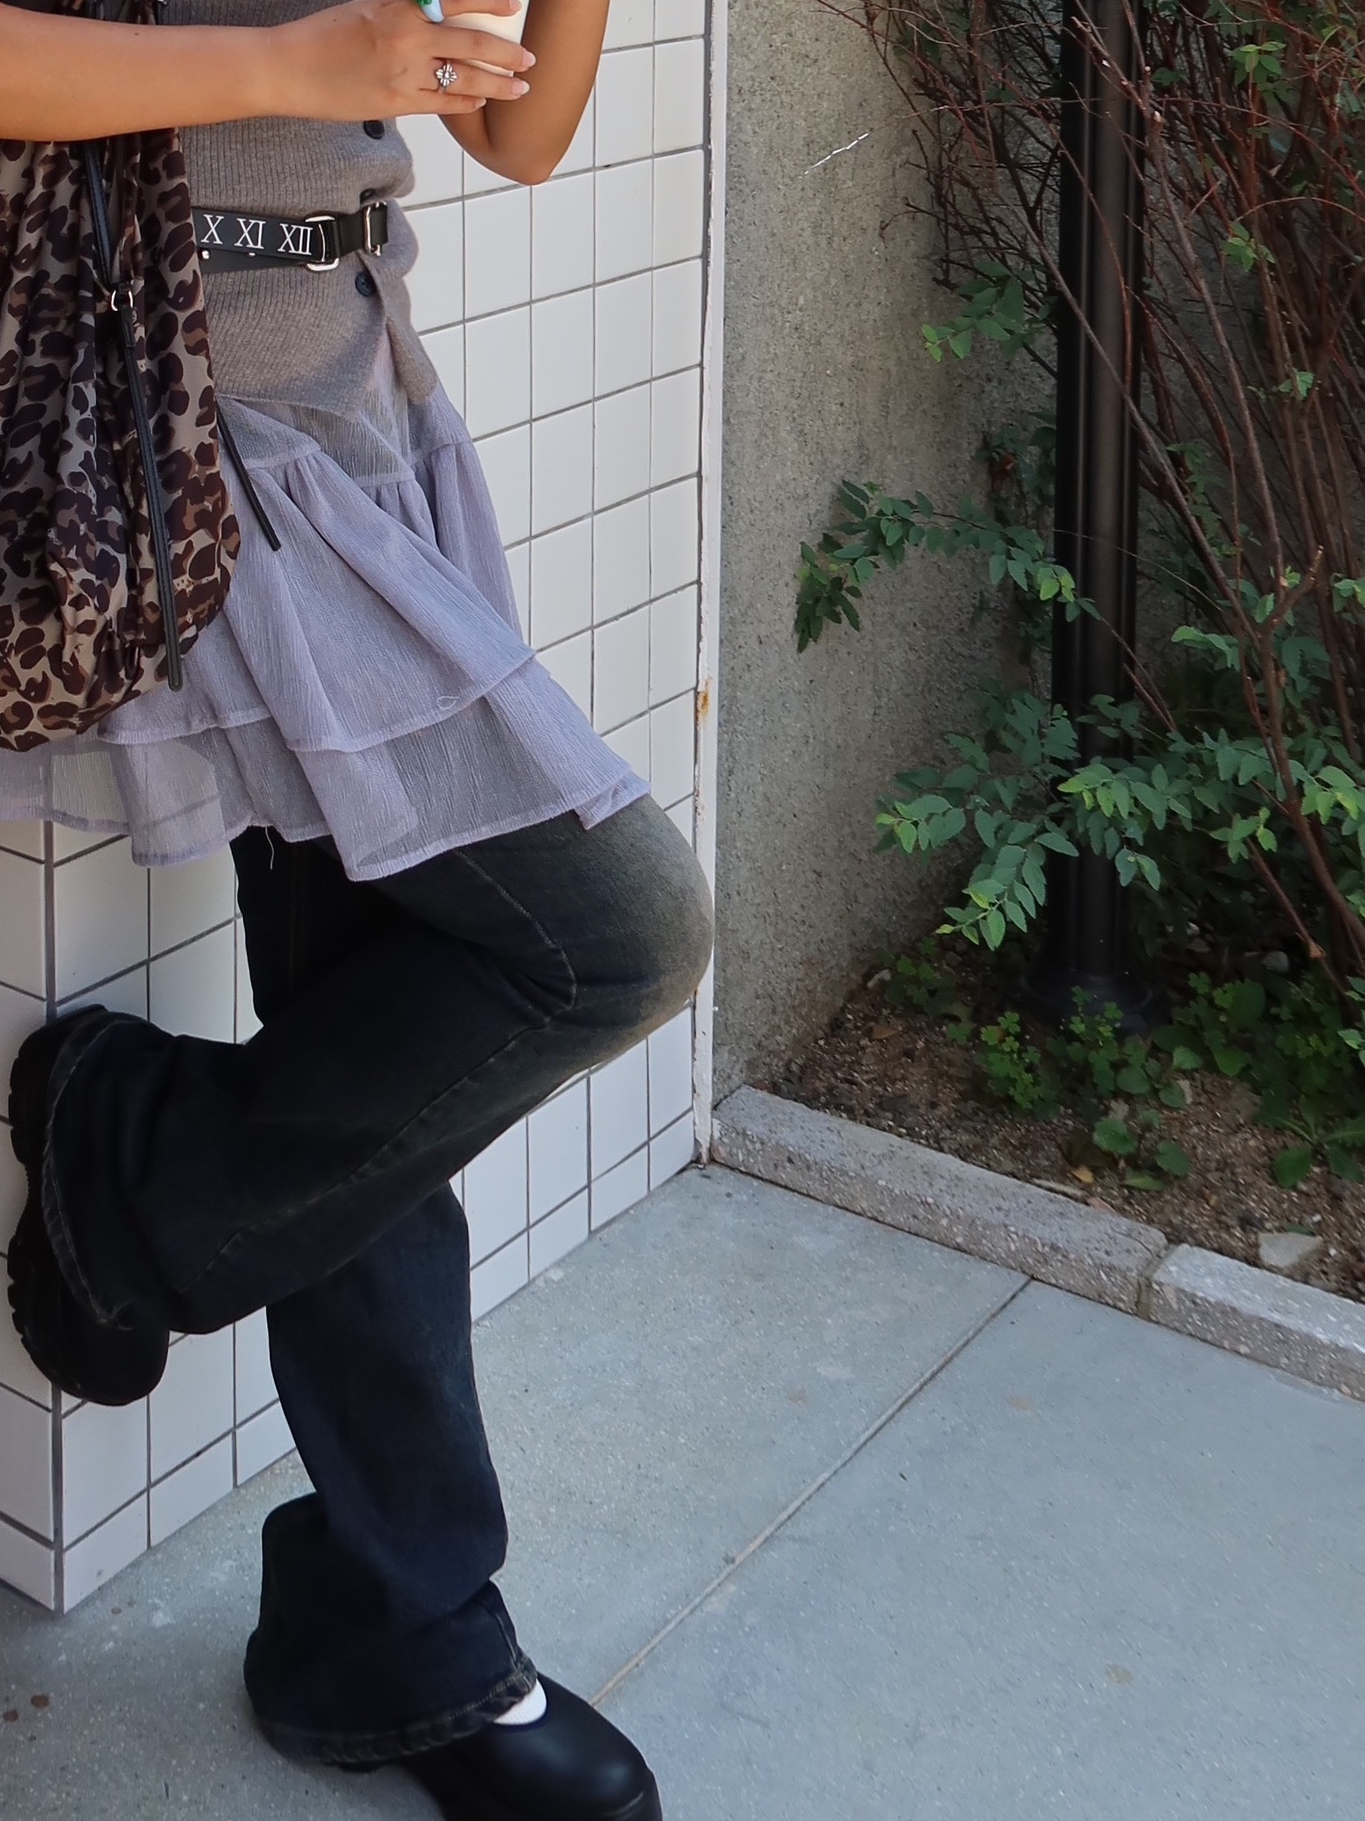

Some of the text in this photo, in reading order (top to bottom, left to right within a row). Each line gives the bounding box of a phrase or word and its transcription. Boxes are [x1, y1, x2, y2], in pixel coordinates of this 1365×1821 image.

[200, 214, 314, 256] X XI XII
